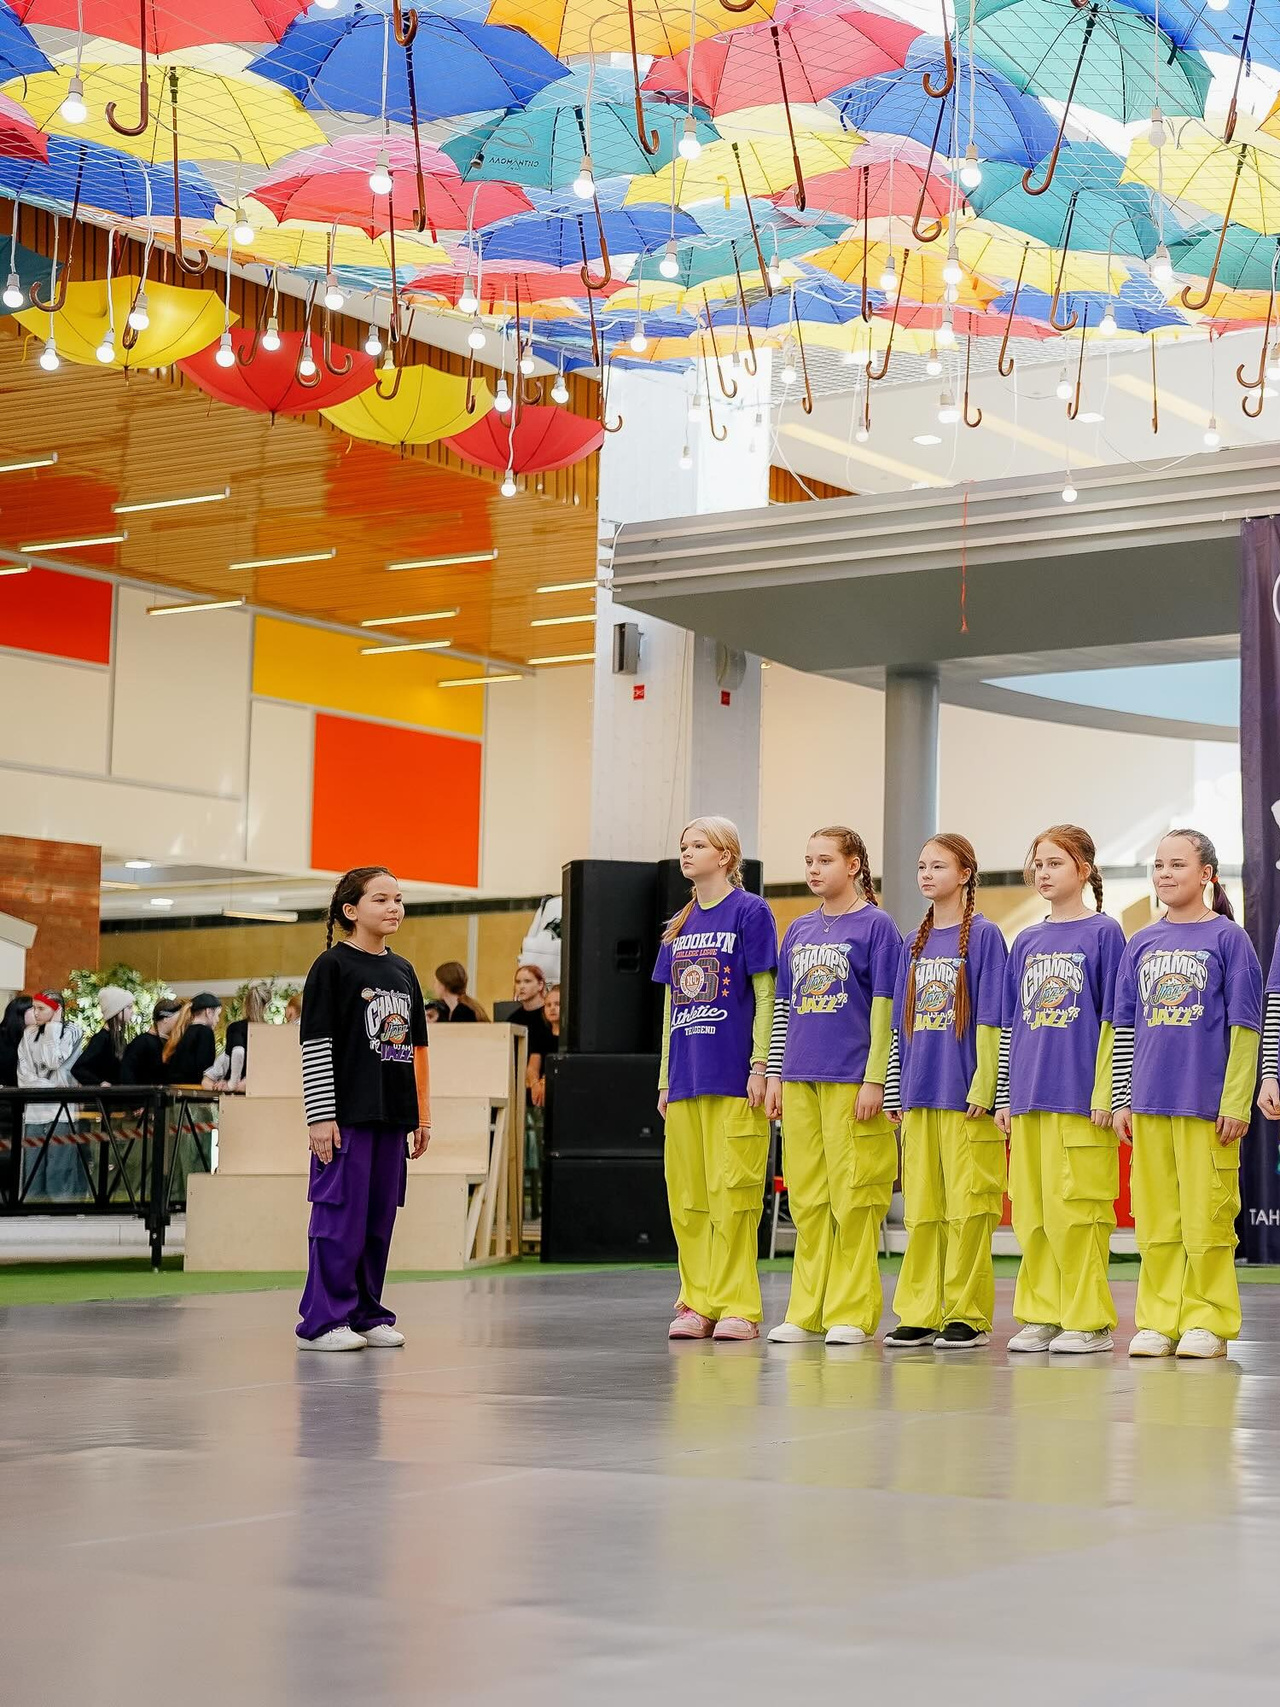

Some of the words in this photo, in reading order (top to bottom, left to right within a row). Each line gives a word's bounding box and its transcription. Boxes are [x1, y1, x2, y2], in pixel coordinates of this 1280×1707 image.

[792, 948, 849, 992] CHAMPS
[1021, 958, 1084, 1009] CHAMPS
[1138, 954, 1208, 1006] CHAMPS
[797, 996, 838, 1015] JAZZ
[1031, 1011, 1069, 1031] JAZZ
[1147, 1007, 1193, 1028] JAZZ
